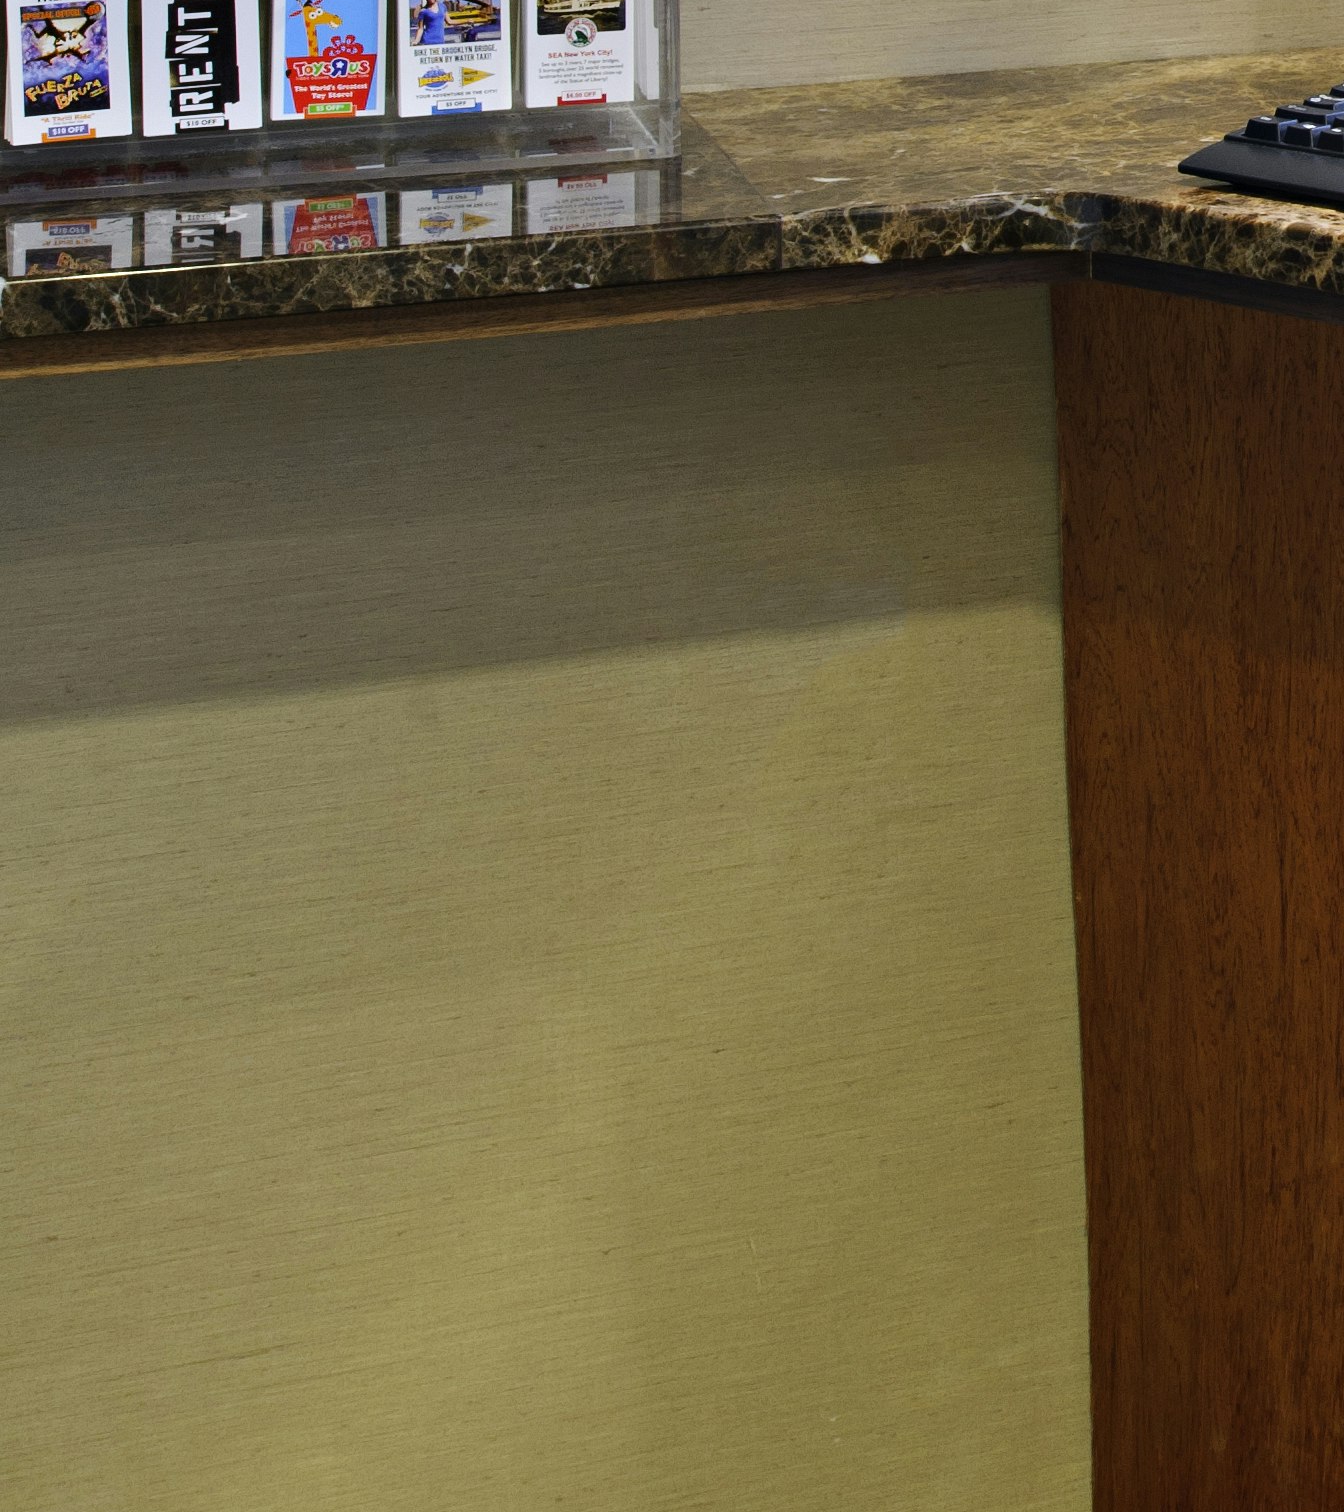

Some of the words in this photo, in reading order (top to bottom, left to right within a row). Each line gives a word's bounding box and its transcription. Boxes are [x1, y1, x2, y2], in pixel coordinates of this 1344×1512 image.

[22, 12, 52, 21] SPECIAL
[53, 8, 80, 18] OFFER
[414, 49, 428, 57] BIKE
[429, 47, 440, 55] THE
[441, 46, 473, 54] BROOKLYN
[177, 6, 215, 112] RENT
[420, 56, 443, 64] RETURN
[444, 55, 452, 63] BY
[454, 54, 474, 62] WATER
[25, 73, 83, 103] FUERZA
[294, 84, 307, 92] The
[309, 83, 336, 91] World's
[337, 82, 367, 91] Greatest
[55, 78, 103, 110] BRUTA
[311, 93, 326, 101] Toy
[328, 91, 353, 99] Store!
[52, 127, 67, 135] $10
[68, 125, 85, 134] OFF
